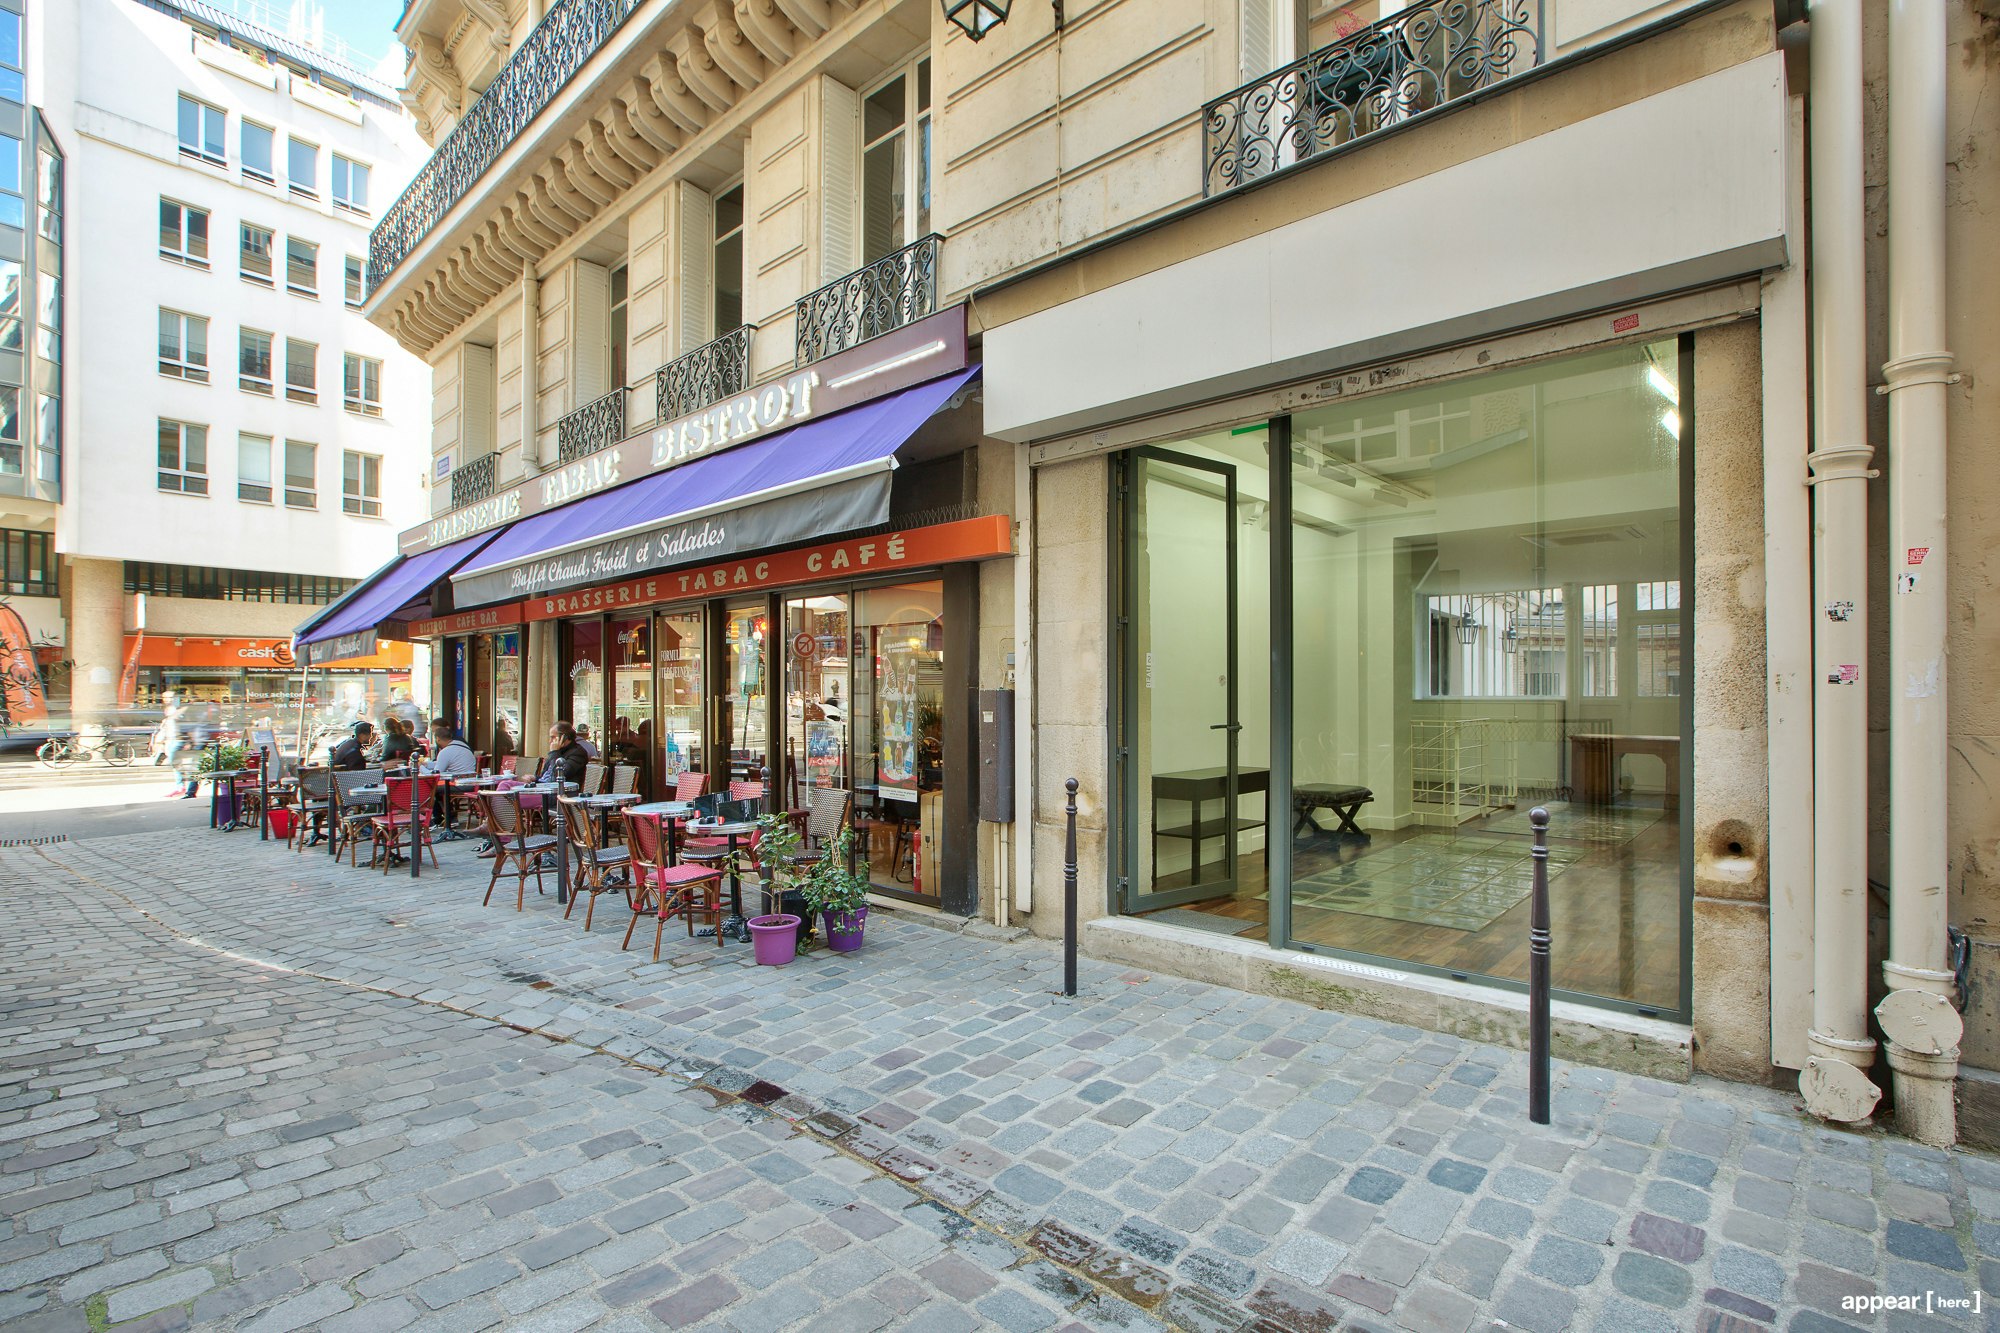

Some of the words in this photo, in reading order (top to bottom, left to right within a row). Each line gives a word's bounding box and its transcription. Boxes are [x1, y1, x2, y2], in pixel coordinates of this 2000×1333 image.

[427, 490, 520, 546] BRASSERIE
[539, 450, 622, 506] TABAC
[651, 370, 820, 467] BISTROT
[511, 563, 547, 590] Buffet
[548, 556, 589, 582] Chaud,
[592, 546, 628, 574] Froid
[636, 543, 649, 562] et
[657, 522, 725, 558] Salades
[545, 581, 657, 611] BRASSERIE
[678, 562, 769, 592] TABAC
[807, 534, 906, 573] CAFÉ
[418, 619, 448, 634] BISTROT
[456, 611, 476, 628] CAFÉ
[480, 611, 498, 625] BAR
